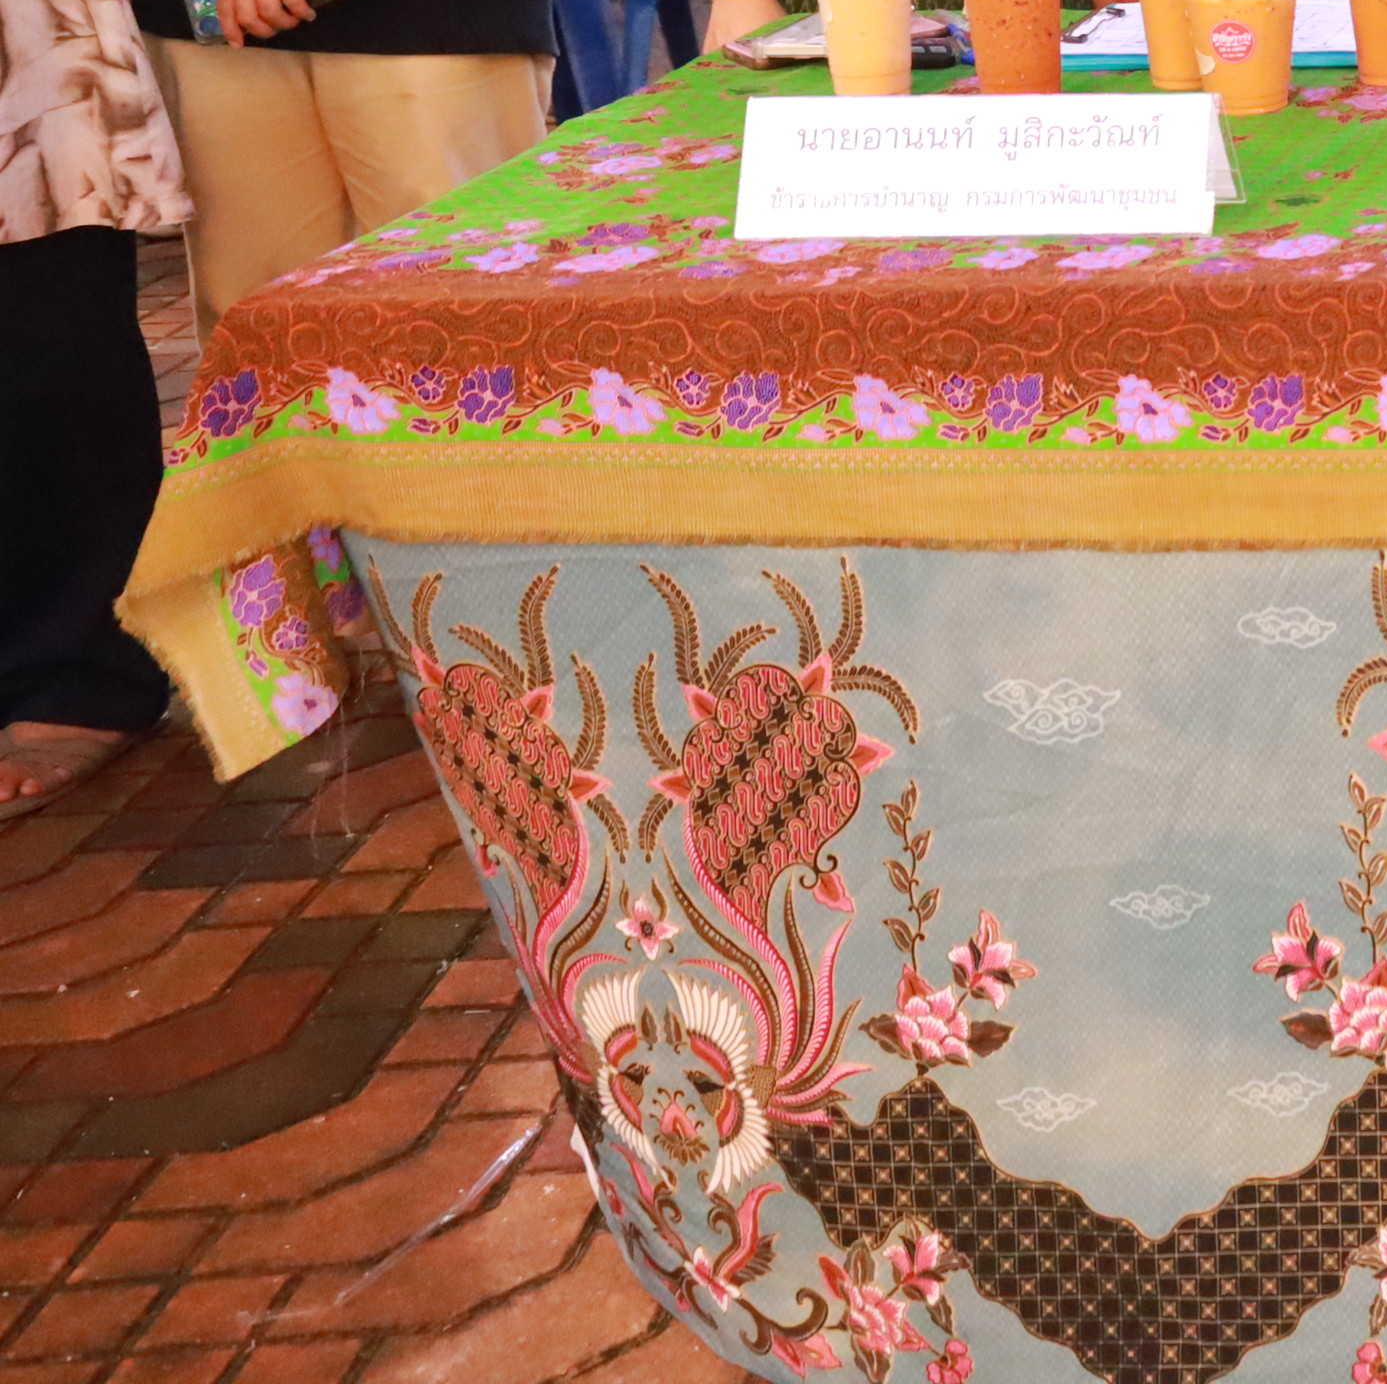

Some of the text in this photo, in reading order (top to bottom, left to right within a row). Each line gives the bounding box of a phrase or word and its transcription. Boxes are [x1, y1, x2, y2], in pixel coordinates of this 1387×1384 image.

[797, 114, 1163, 161] นายอานนท์ มูสิกะวัณท์
[967, 183, 1176, 211] กรมการพัฒนาชุมชน
